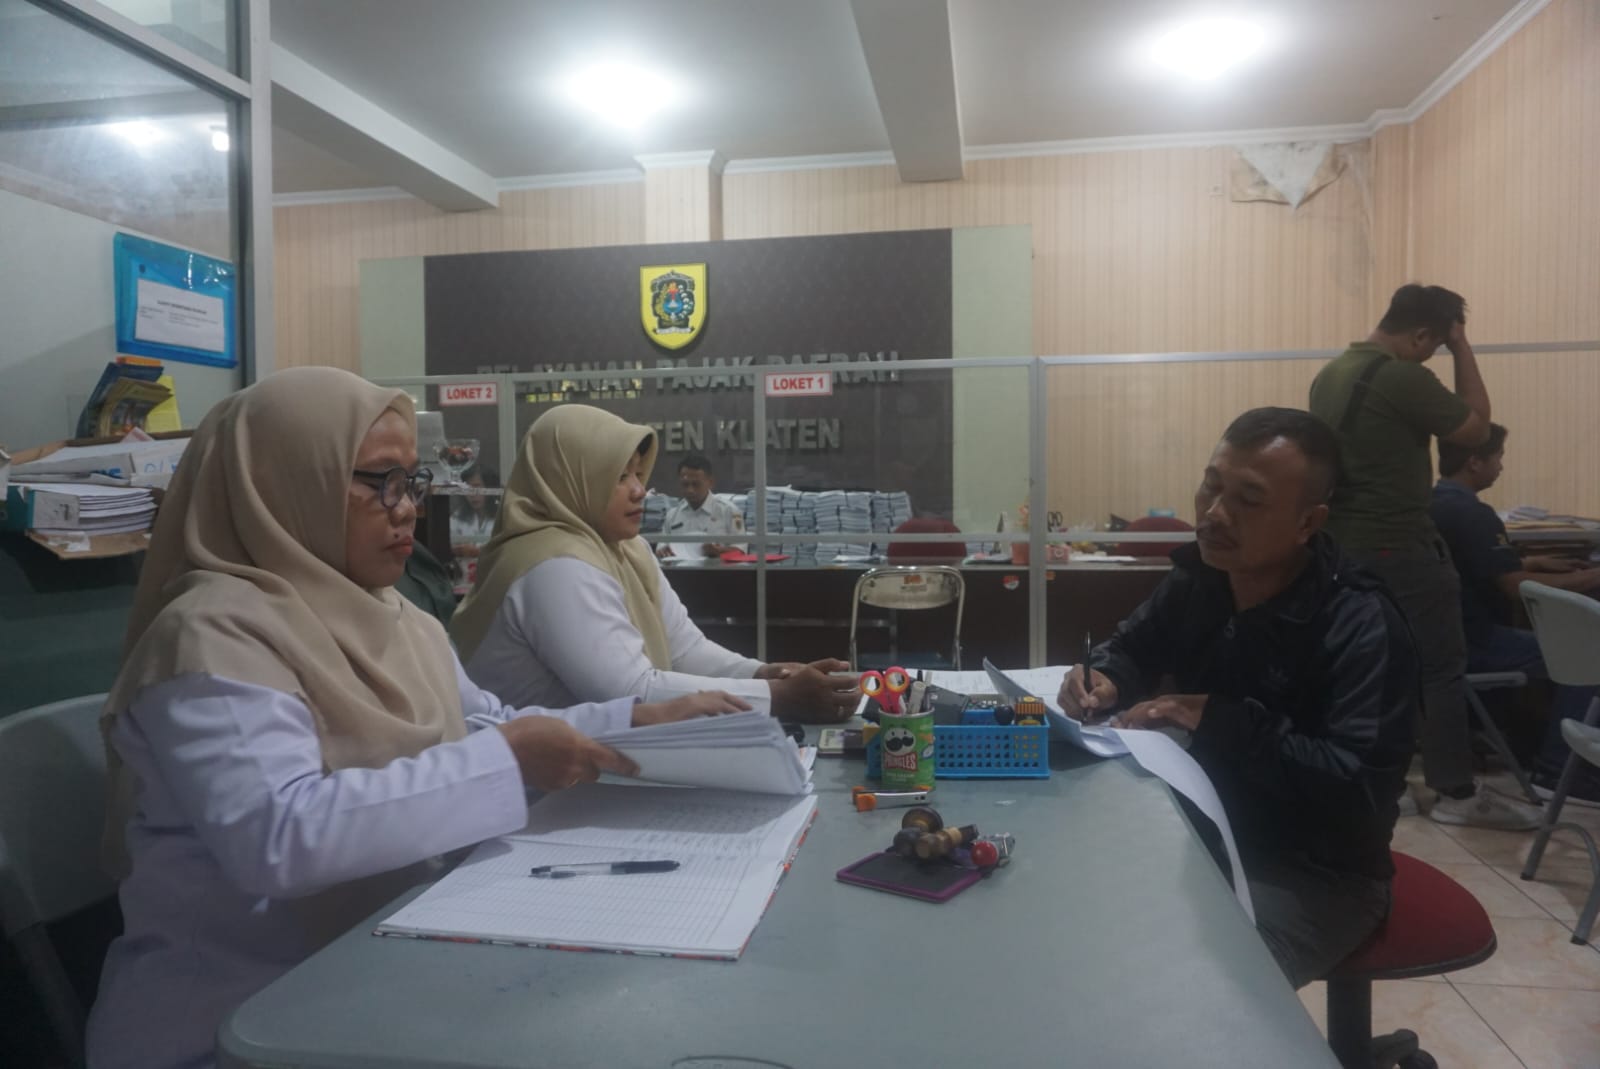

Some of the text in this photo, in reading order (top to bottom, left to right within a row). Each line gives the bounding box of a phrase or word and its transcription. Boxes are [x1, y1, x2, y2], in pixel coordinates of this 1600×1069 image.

[656, 355, 754, 390] PAJAK
[772, 376, 824, 391] LOKET 1
[446, 386, 493, 400] LOKET 2
[716, 418, 840, 451] KLATEN
